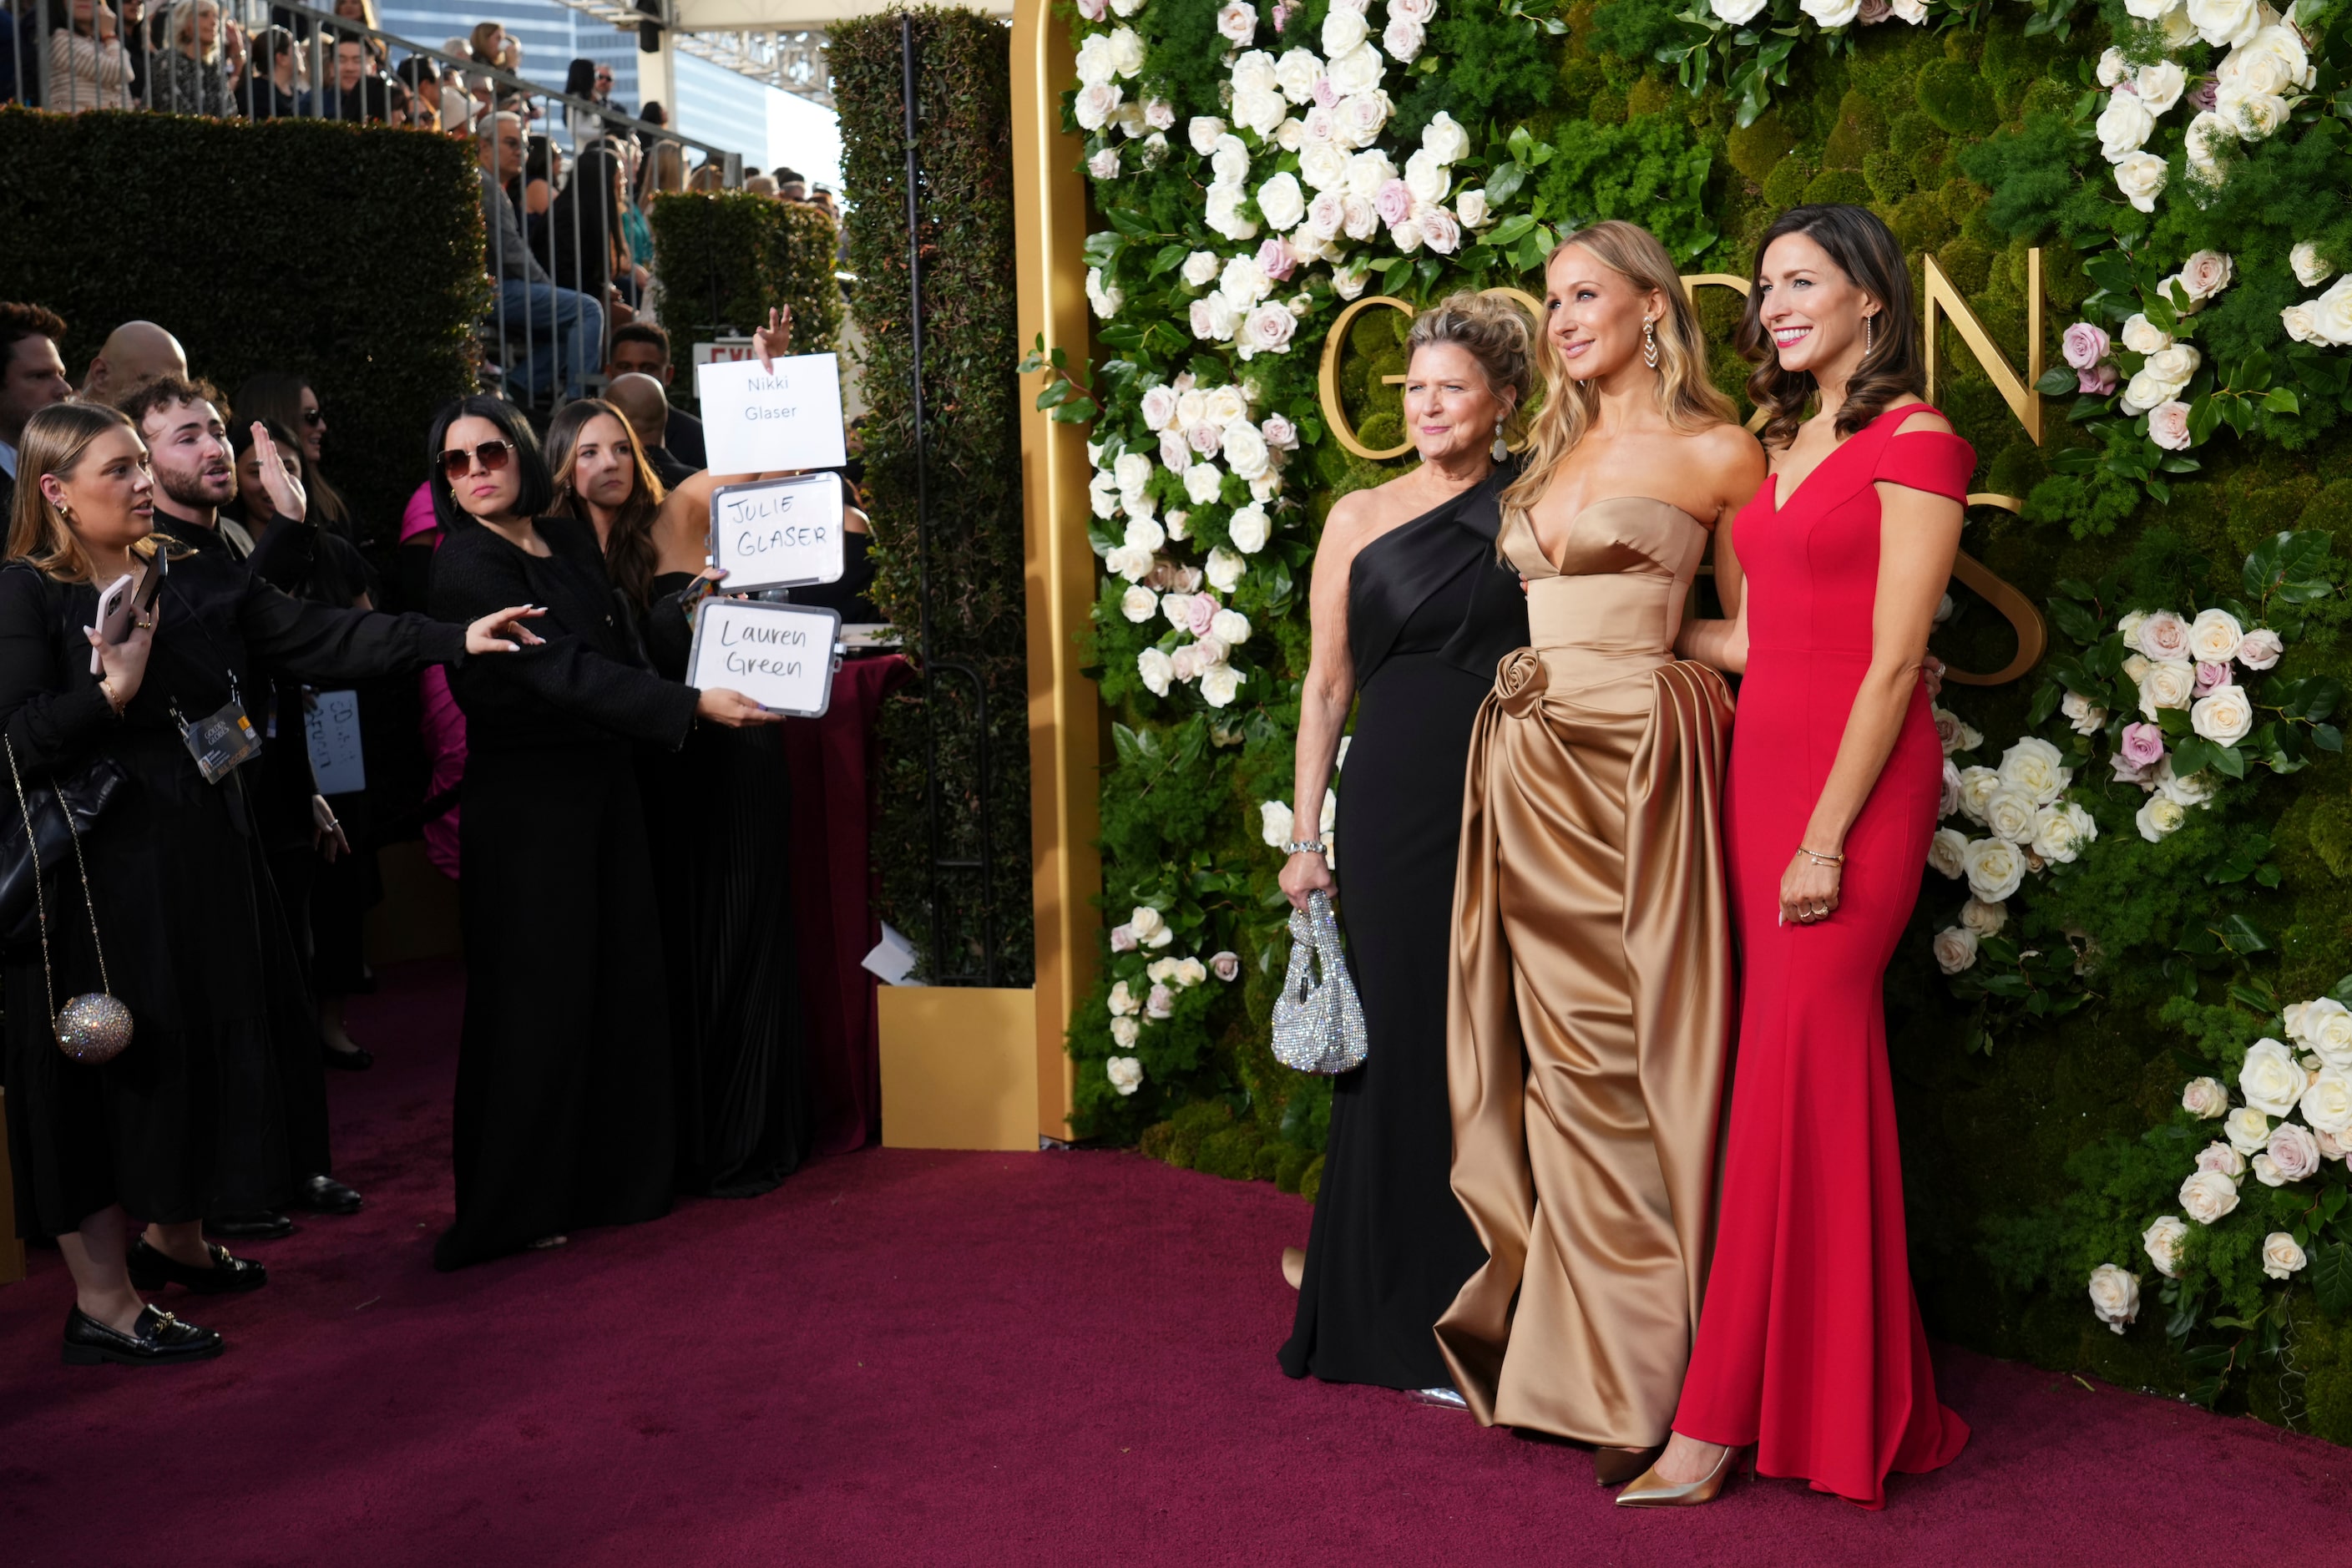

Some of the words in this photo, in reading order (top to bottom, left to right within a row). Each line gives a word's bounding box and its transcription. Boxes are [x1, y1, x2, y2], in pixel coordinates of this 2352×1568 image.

[747, 375, 788, 392] Nikki
[745, 406, 797, 421] Glaser
[727, 495, 794, 524] JULIE
[737, 526, 827, 556] GLASER
[721, 620, 806, 647] Lauren
[726, 650, 802, 678] Green
[204, 721, 226, 740] GOLDEN
[208, 726, 230, 746] GLOBES
